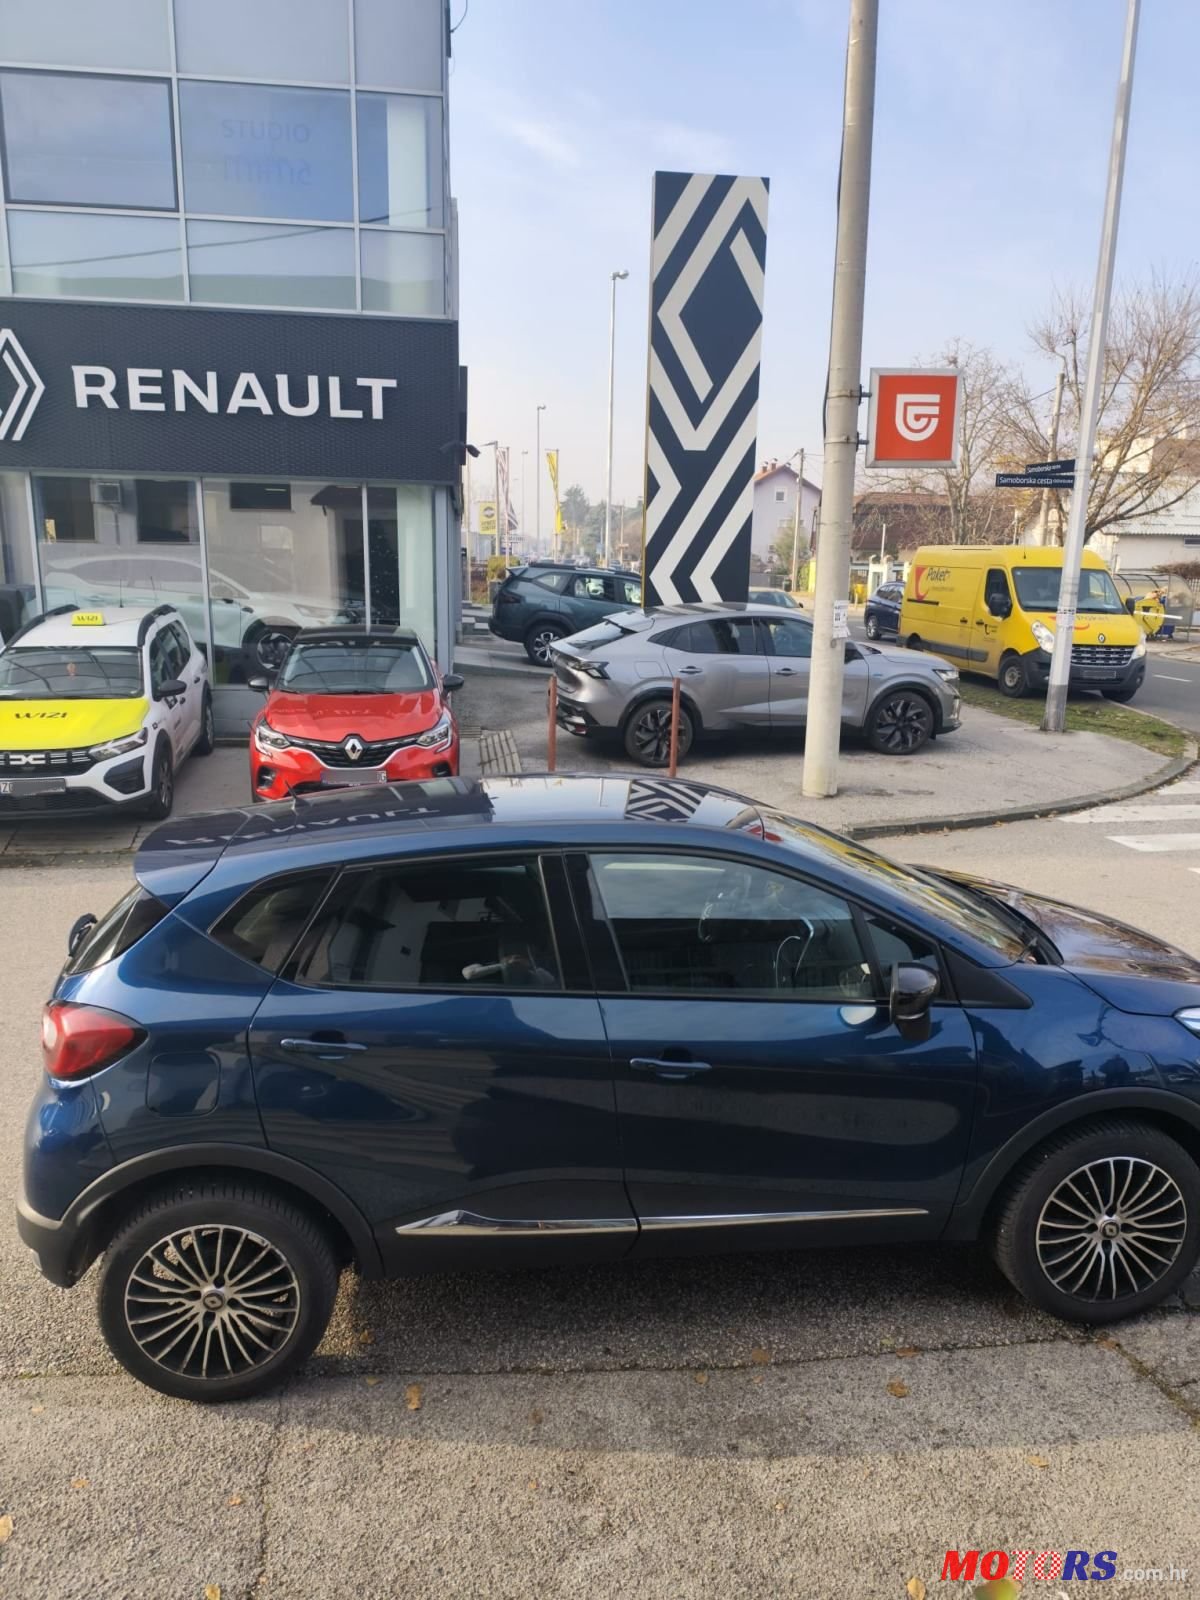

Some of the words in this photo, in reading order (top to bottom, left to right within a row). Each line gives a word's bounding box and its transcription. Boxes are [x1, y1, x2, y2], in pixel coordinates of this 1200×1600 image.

[220, 118, 311, 144] STUDIO
[71, 364, 398, 421] RENAULT
[999, 476, 1037, 484] Samoborska
[1036, 477, 1053, 485] cesta
[14, 711, 68, 719] WIZI
